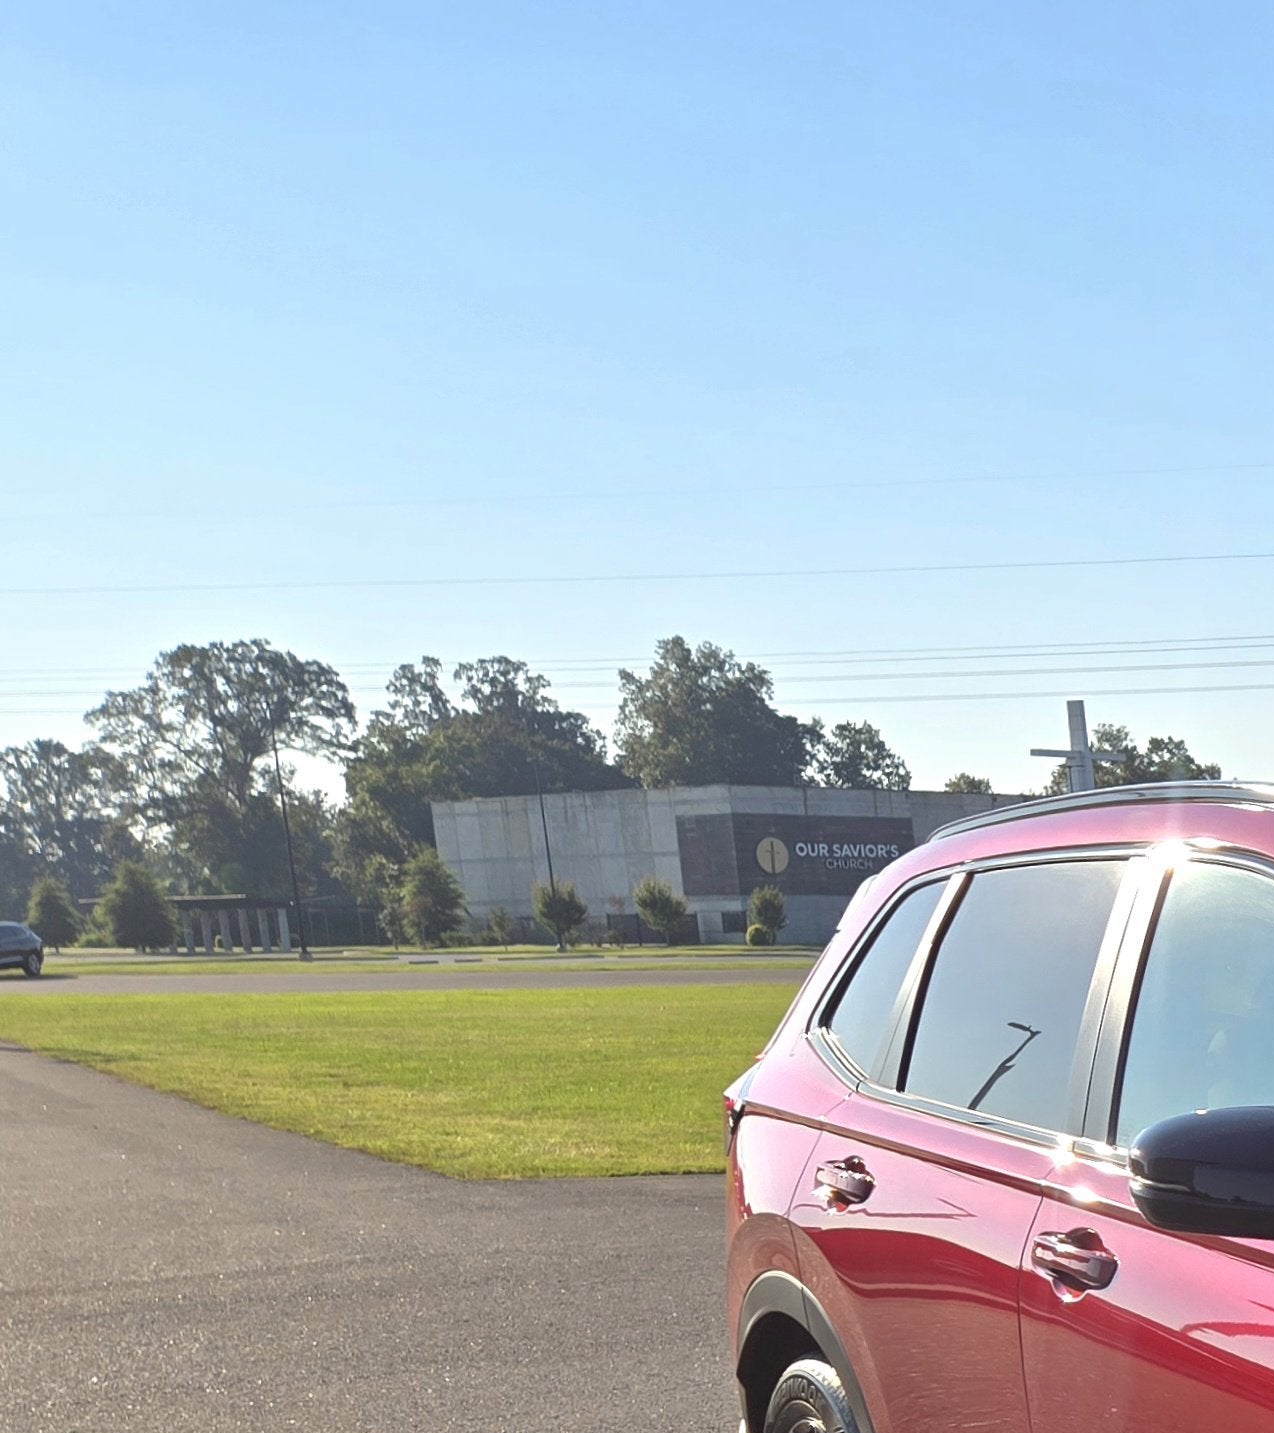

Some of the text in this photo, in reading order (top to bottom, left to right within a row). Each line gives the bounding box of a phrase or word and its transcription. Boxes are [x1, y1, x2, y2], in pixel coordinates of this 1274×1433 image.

[795, 842, 899, 858] OUR SAVIOR'S
[825, 858, 874, 870] CHURCH
